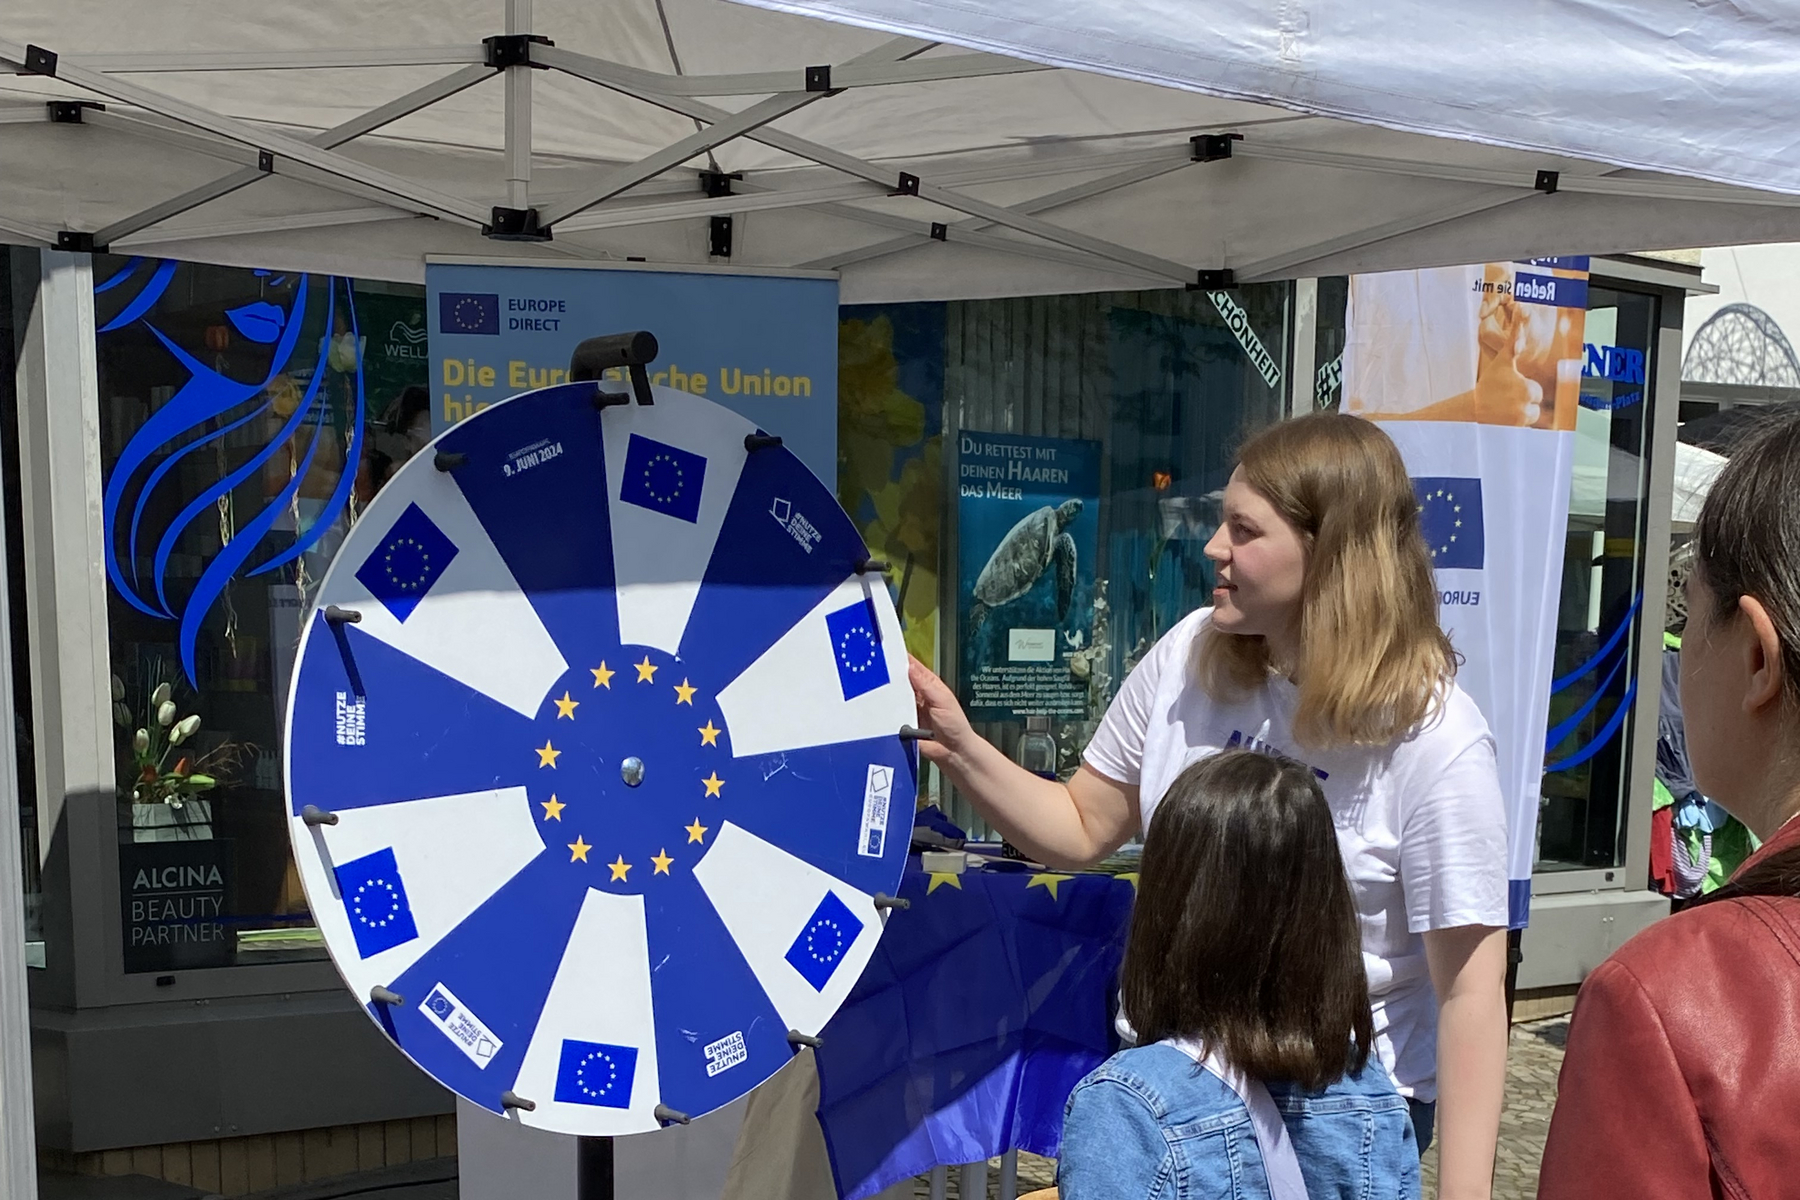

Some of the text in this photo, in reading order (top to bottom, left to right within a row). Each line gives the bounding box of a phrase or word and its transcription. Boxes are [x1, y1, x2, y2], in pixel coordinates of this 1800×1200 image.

[508, 299, 566, 313] EUROPE
[509, 318, 561, 331] DIRECT
[1210, 291, 1280, 383] CHÖNHEIT
[384, 343, 428, 359] WELL
[1581, 343, 1645, 384] NER
[443, 358, 811, 397] Die Eurche Union
[503, 464, 516, 477] 9.
[516, 452, 540, 472] JUNI
[538, 442, 563, 462] 2024
[985, 443, 1033, 459] RETTEST
[961, 464, 1005, 479] DEINEN
[961, 484, 984, 498] DAS
[786, 524, 813, 554] STIMME
[790, 518, 813, 543] DEINE
[794, 512, 822, 543] #NUTZE
[336, 691, 347, 745] #NUTZE
[346, 705, 356, 745] DEINE
[355, 695, 366, 746] STIMME
[133, 864, 224, 890] ALCINA
[132, 896, 224, 921] BEAUTY
[132, 923, 225, 946] PARTNER
[448, 1022, 473, 1046] #NUTZE
[457, 1012, 482, 1037] STIMME
[458, 1023, 478, 1043] DEINE
[707, 1033, 741, 1056] STIMME
[716, 1041, 744, 1060] DEINE
[709, 1050, 745, 1074] #NUTZE
